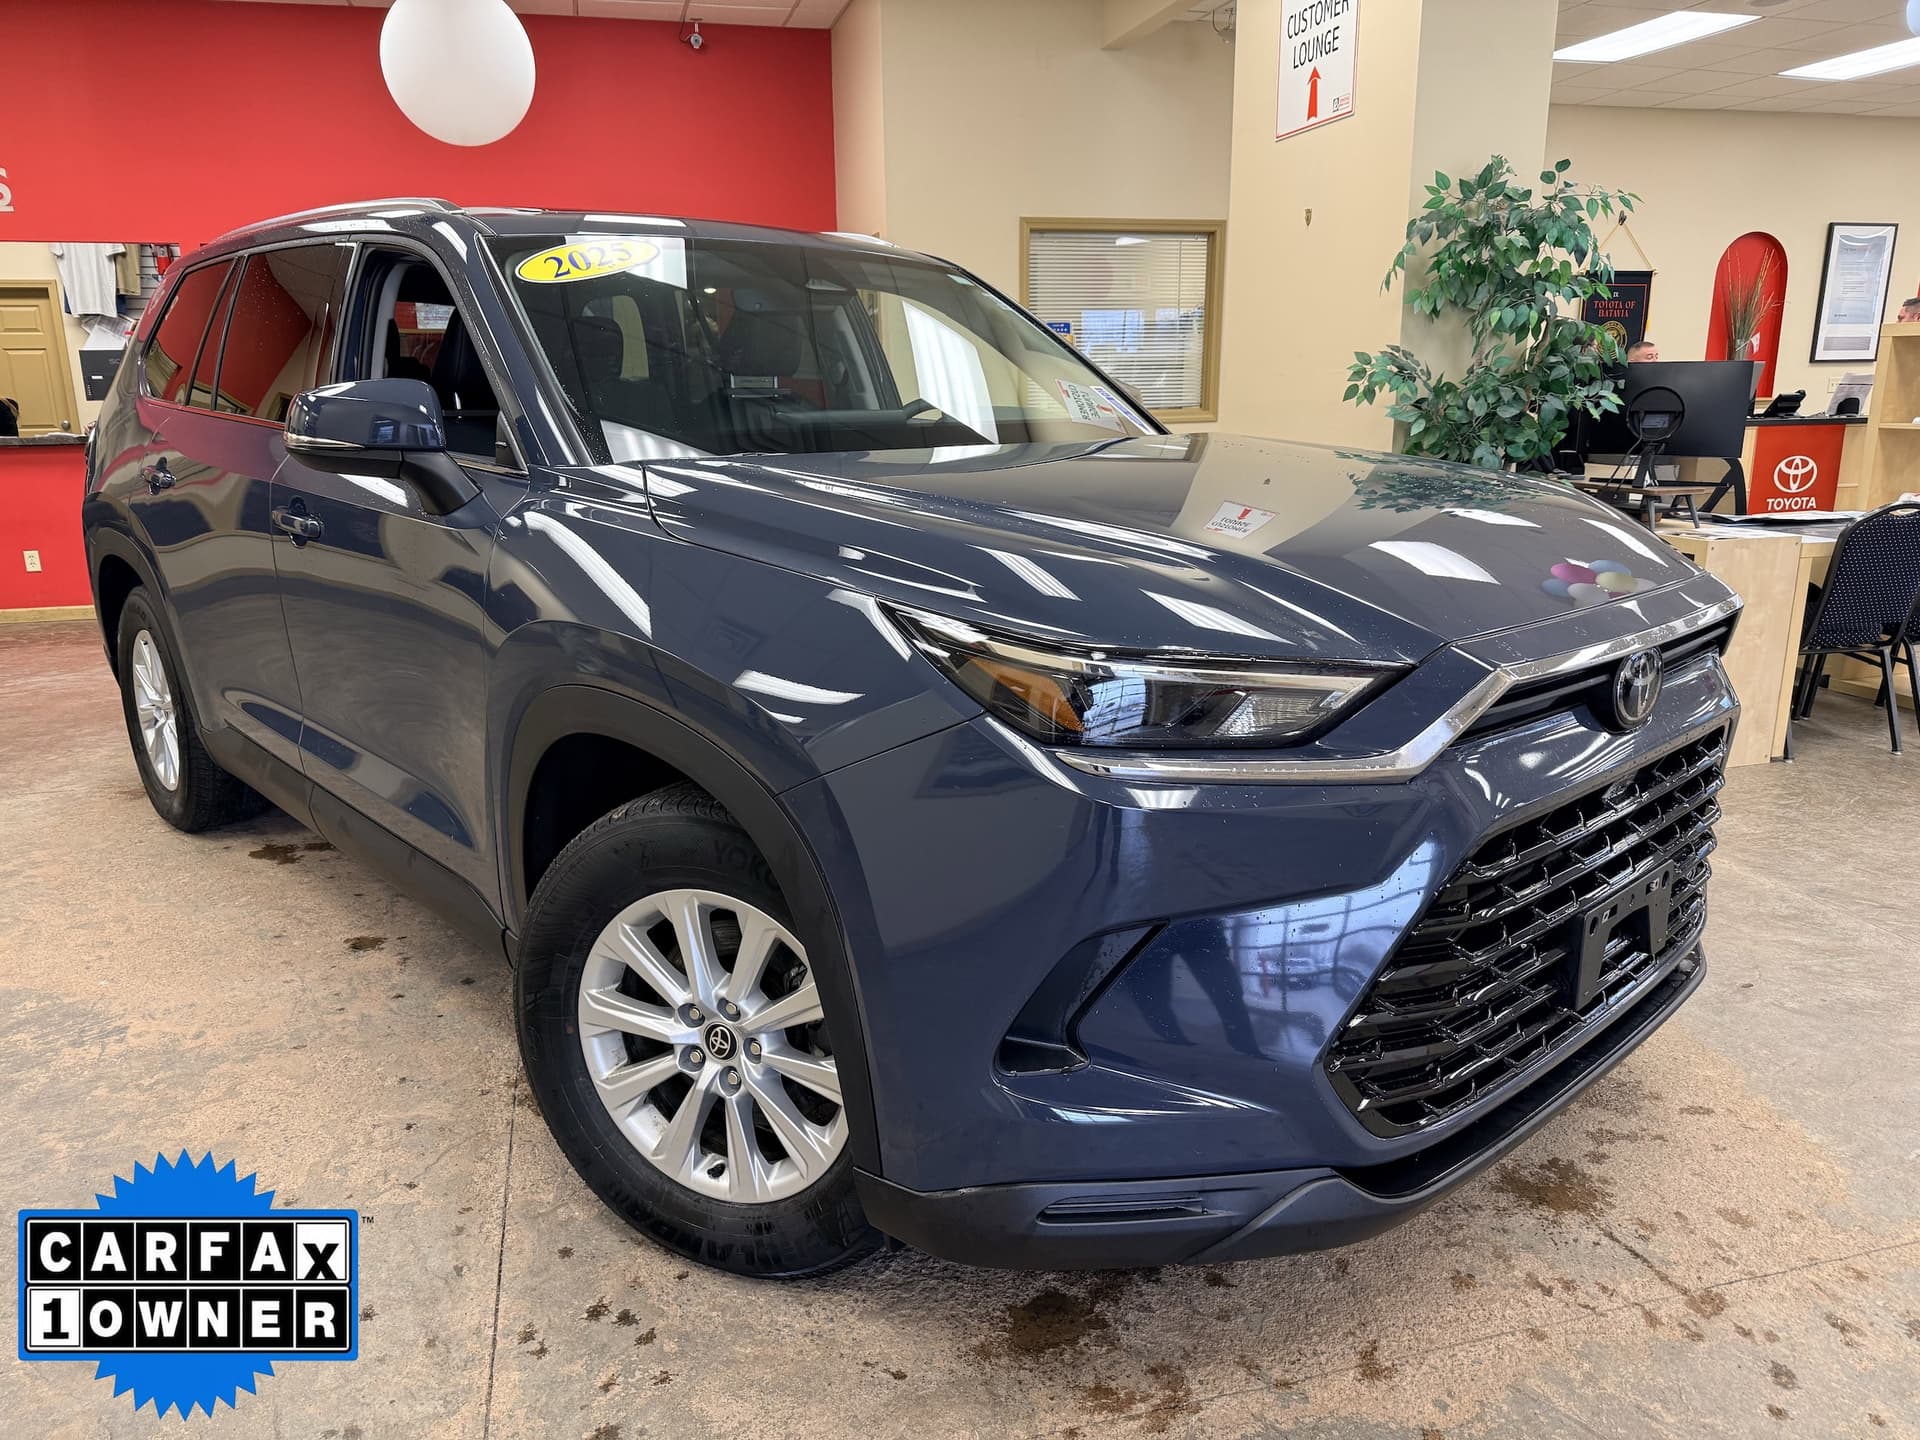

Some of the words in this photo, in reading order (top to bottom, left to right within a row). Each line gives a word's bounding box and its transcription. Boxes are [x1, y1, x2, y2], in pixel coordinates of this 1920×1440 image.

[1287, 0, 1349, 39] CUSTOMER
[1293, 26, 1340, 69] LOUNGE
[543, 242, 633, 279] 2025
[1593, 300, 1623, 309] TOYOTA
[1625, 300, 1637, 309] OF
[1598, 309, 1629, 318] BATAVIA
[1766, 496, 1817, 511] TOYOTA
